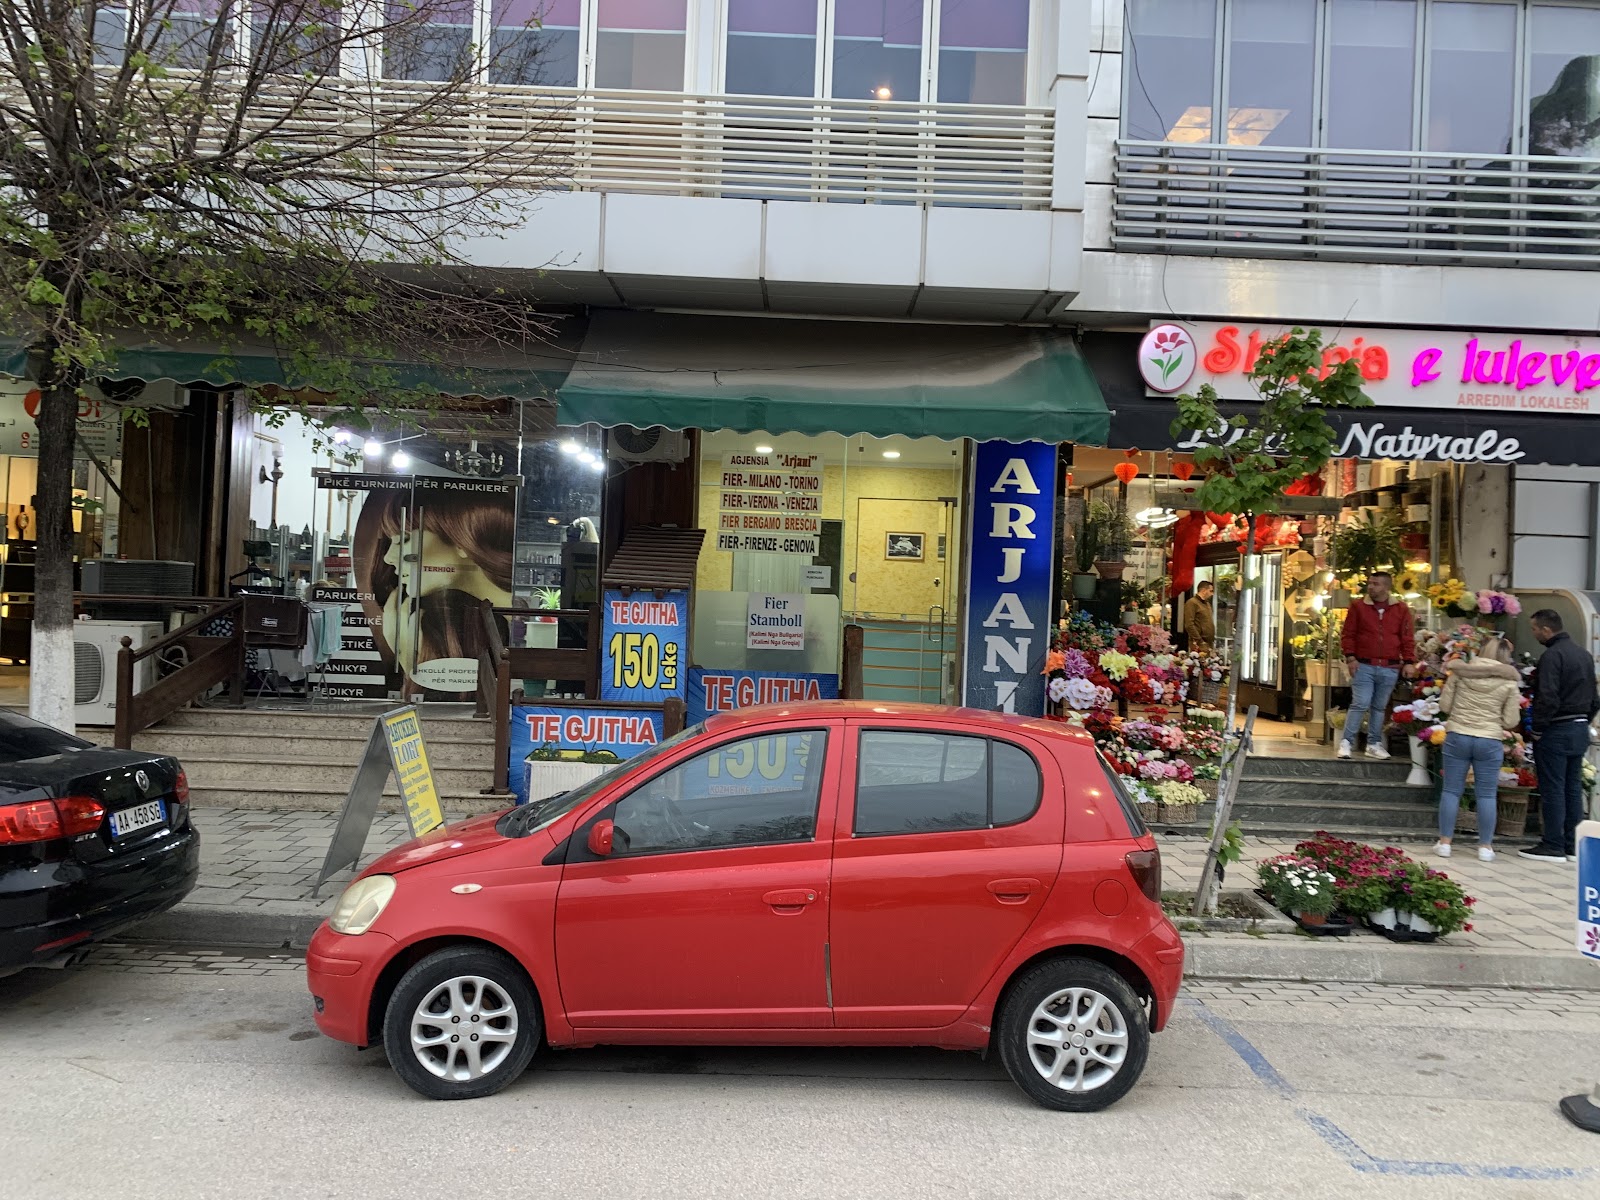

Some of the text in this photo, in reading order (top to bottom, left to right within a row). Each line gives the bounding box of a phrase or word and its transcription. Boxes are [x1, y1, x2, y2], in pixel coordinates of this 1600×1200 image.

[1412, 348, 1443, 387] e
[1461, 338, 1600, 393] luleve
[1457, 393, 1590, 410] ARREDIM LOKALESH
[731, 455, 769, 466] AGJENSIA
[354, 479, 412, 490] FURNIZIMI
[415, 478, 439, 490] PËR
[443, 481, 509, 493] PARUKIERE
[721, 515, 817, 531] FIER BERGAMO BRESCIA
[983, 458, 1041, 716] ARJANI
[315, 590, 376, 601] PARUKERI
[764, 596, 789, 610] Fier
[341, 616, 383, 626] METIKË
[611, 601, 679, 626] TE GJITHA
[750, 613, 802, 627] Stamboll
[341, 639, 373, 649] ETIKË
[609, 631, 660, 690] 150
[660, 641, 678, 690] Leke
[702, 675, 821, 711] TE GJITHA
[526, 714, 658, 745] TE GJITHA
